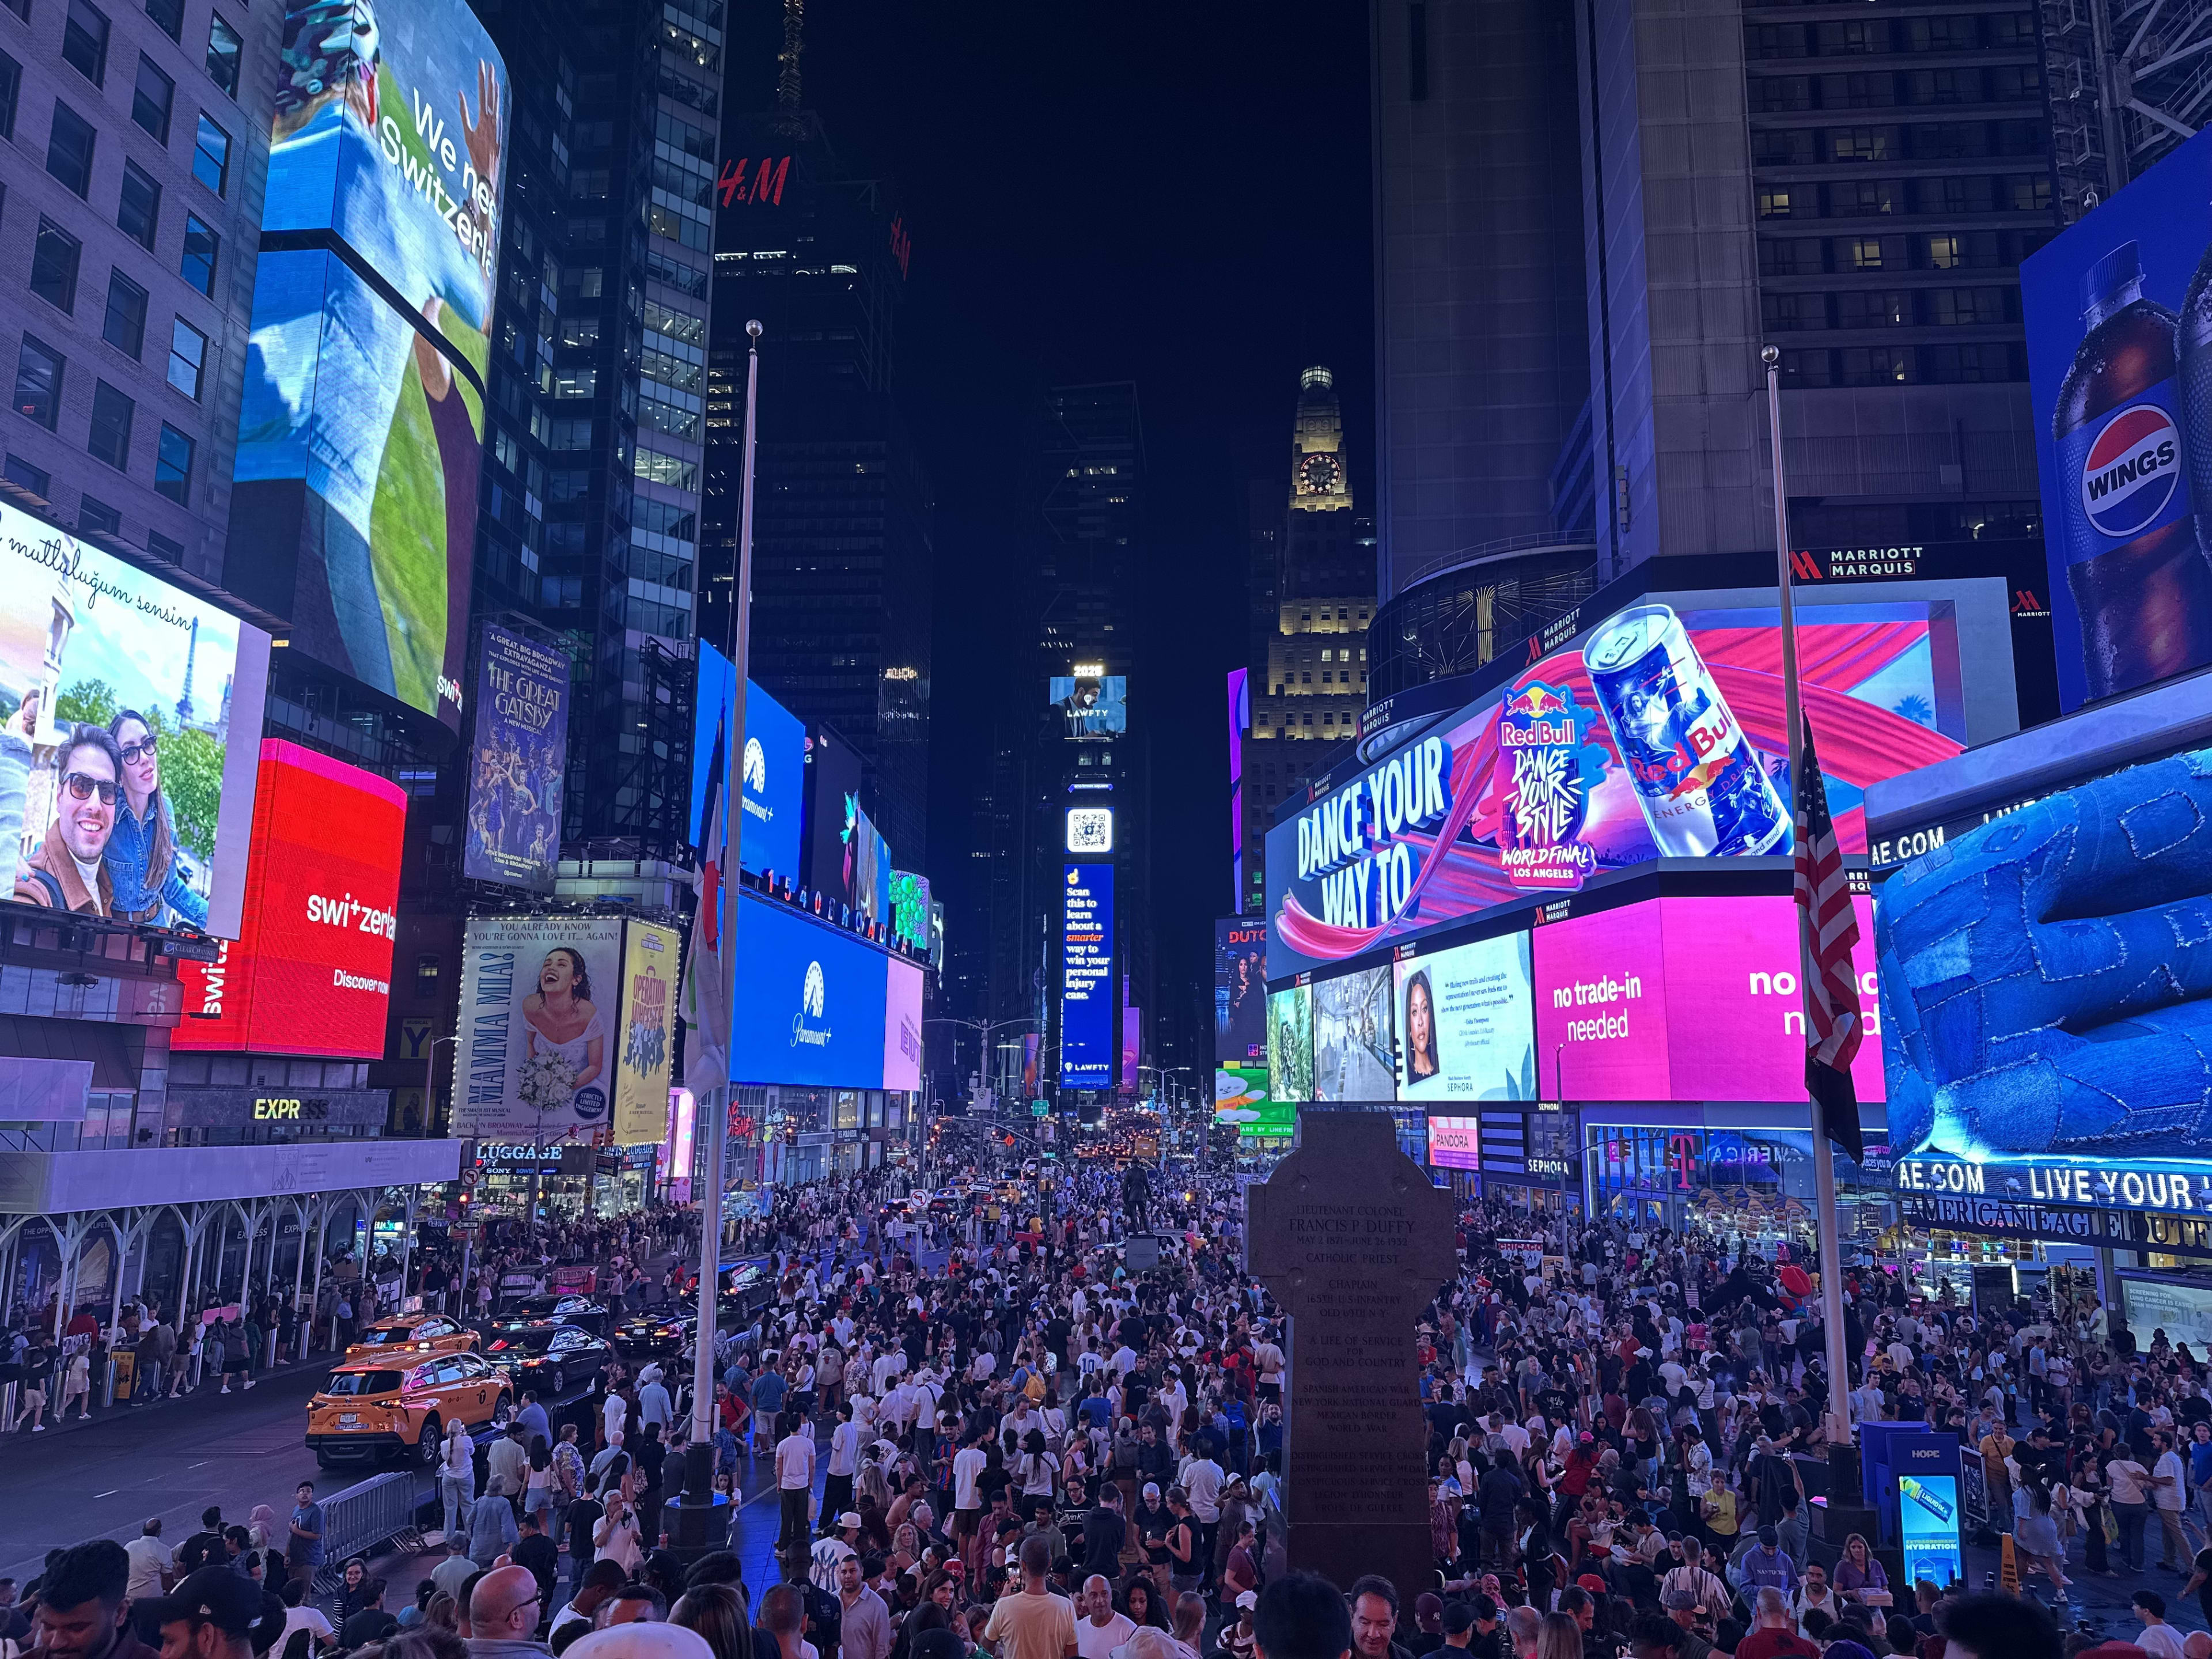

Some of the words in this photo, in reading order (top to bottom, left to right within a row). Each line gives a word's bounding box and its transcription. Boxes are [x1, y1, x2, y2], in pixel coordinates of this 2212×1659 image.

[414, 87, 456, 172] We
[718, 156, 790, 207] H&M
[2088, 441, 2175, 501] WINGS
[1831, 547, 1923, 562] MARRIOTT
[1832, 562, 1912, 575] MARQUIS
[137, 596, 191, 630] sensin
[1544, 608, 1580, 638] MARRIOTT
[1544, 625, 1576, 651] MARQUIS
[497, 635, 518, 650] GREAT,
[520, 645, 531, 655] BIG
[532, 653, 565, 669] BROADWAY
[488, 650, 499, 658] THAT
[499, 655, 520, 667] EXPLODES
[521, 664, 531, 672] WITH
[504, 648, 551, 673] EXTRAVAGANZA
[1074, 666, 1103, 676] 2025
[489, 666, 514, 694] THE
[516, 677, 562, 712] GREAT
[495, 692, 552, 729] GATSBY
[1067, 709, 1109, 717] LAWFTY
[1362, 698, 1394, 721] MARRIOTT
[509, 719, 520, 728] NEW
[521, 723, 543, 736] MUSICAL
[1362, 713, 1389, 734] MARQUIS
[1502, 722, 1536, 746] Red
[1537, 718, 1575, 745] Bull
[1631, 742, 1692, 783] Red
[1688, 695, 1733, 756] Bull
[1512, 747, 1570, 783] DANCE
[1315, 773, 1331, 789] MARRIOTT
[1315, 783, 1330, 798] MARQUIS
[1517, 769, 1563, 808] YOUR
[1298, 782, 1362, 880] DANCE
[1368, 736, 1446, 842] YOUR
[1654, 790, 1715, 820] ENERGY
[1516, 793, 1574, 844] STYLE
[1872, 826, 1944, 866] AE.COM
[498, 851, 522, 862] BROADWAY
[1502, 844, 1549, 869] WORLD
[1547, 843, 1593, 868] FINAL
[510, 861, 533, 870] BROADWAY
[1513, 868, 1531, 878] LOS
[1533, 868, 1574, 879] ANGELES
[1066, 888, 1089, 896] Scan
[1321, 858, 1372, 929] WAY
[1377, 842, 1412, 924] TO
[1067, 899, 1085, 908] this
[1086, 899, 1097, 908] to
[1546, 899, 1570, 912] MARRIOTT
[1066, 910, 1092, 919] learn
[1546, 908, 1568, 921] MARQUIS
[521, 923, 562, 931] ALREADY
[1066, 922, 1094, 931] about
[474, 933, 505, 941] YOU'RE
[507, 933, 539, 941] GONNA
[542, 933, 566, 941] LOVE
[586, 932, 618, 941] AGAIN!
[1066, 934, 1104, 942] smarter
[1066, 946, 1086, 956] way
[1087, 945, 1099, 953] to
[1066, 956, 1085, 965] win
[1086, 957, 1110, 967] your
[476, 952, 514, 1006] MIA!
[1066, 967, 1107, 978] personal
[334, 969, 377, 991] Discover
[1066, 979, 1096, 989] injury
[1749, 971, 1796, 995] no
[633, 974, 666, 1004] OPERATION
[1066, 991, 1089, 999] case.
[1554, 986, 1572, 1008] no
[1574, 971, 1641, 1005] trade-in
[790, 1013, 832, 1047] Paramount+
[1567, 1008, 1628, 1041] needed
[404, 1027, 432, 1058] Y
[468, 1012, 510, 1105] MAMMA
[1448, 1083, 1474, 1092] SEPHORA
[579, 1099, 600, 1107] LIMITED
[580, 1093, 603, 1102] STRICTLY
[254, 1099, 329, 1119] EXPRESS
[1436, 1130, 1469, 1149] PANDORA
[476, 1146, 563, 1160] LUGGAGE
[627, 1143, 654, 1156] LUGGAGE
[1899, 1162, 1985, 1194] AE.COM
[2029, 1168, 2094, 1202] LIVE
[2101, 1171, 2192, 1209] YOUR
[1297, 1205, 1354, 1215] LIEUTENANT
[1358, 1206, 1405, 1216] COLONEL
[1908, 1196, 2032, 1230] AMERICAN
[2038, 1204, 2122, 1240] EAGLE
[1289, 1219, 1347, 1232] FRANCIS
[1367, 1221, 1415, 1233] DUFFY
[1297, 1236, 1315, 1244] MAY
[1351, 1237, 1372, 1245] JUNE
[1499, 1243, 1543, 1251] CHICAGO
[1705, 1244, 1715, 1252] 25
[1306, 1253, 1357, 1263] CATHOLIC
[1363, 1254, 1399, 1264] PRIEST
[1328, 1279, 1378, 1289] CHAPLAIN
[2129, 1288, 2159, 1297] SCREENING
[1357, 1296, 1401, 1305] INFANTRY
[2145, 1297, 2166, 1305] CANCER
[1320, 1309, 1340, 1317] OLD
[1310, 1336, 1316, 1345] A
[1321, 1336, 1341, 1345] LIFE
[1345, 1336, 1358, 1345] OF
[1362, 1336, 1403, 1346] SERVICE
[1082, 1358, 1095, 1373] 10
[1306, 1357, 1329, 1367] GOD
[1332, 1358, 1354, 1366] AND
[1358, 1358, 1407, 1368] COUNTRY
[1304, 1385, 1338, 1393] SPANISH
[1341, 1385, 1387, 1393] AMERICAN
[1389, 1386, 1410, 1394] WAR
[1315, 1398, 1338, 1406] YORK
[1342, 1399, 1387, 1407] NATIONAL
[1389, 1399, 1421, 1407] GUARD
[1361, 1412, 1397, 1420] BORDER
[1328, 1425, 1361, 1433] WORLD
[1367, 1425, 1388, 1433] WAR
[1912, 1450, 1940, 1458] HOPE
[1921, 1492, 1940, 1509] LIQUID
